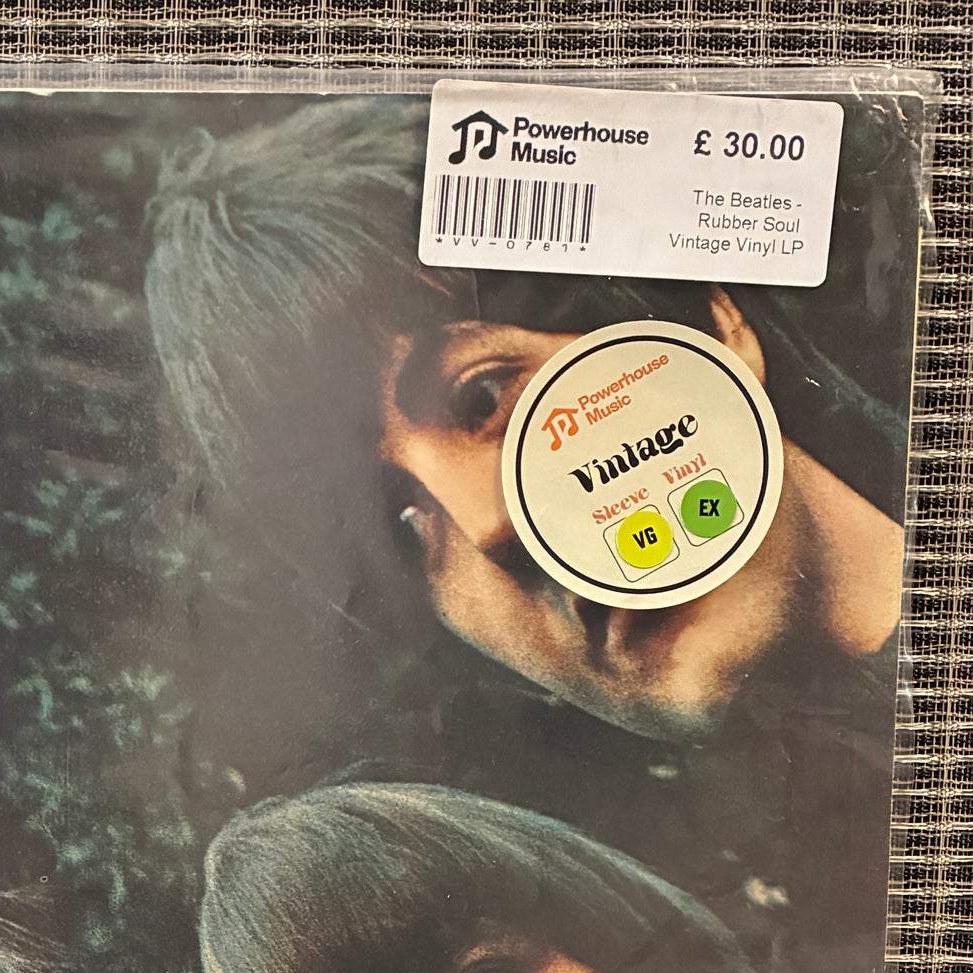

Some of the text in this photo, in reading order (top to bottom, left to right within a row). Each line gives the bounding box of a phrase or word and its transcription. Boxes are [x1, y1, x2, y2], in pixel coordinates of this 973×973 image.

[513, 116, 650, 146] Powerhouse
[693, 130, 805, 161] £ 30.00
[510, 142, 577, 166] Music
[692, 189, 725, 207] The
[730, 192, 792, 211] Beatles
[698, 213, 800, 234] Rubber Soul
[669, 233, 804, 257] Vintage Vinyl LP
[577, 353, 669, 411] Powerhouse
[585, 393, 632, 426] Music
[567, 414, 699, 493] Vintage
[661, 453, 707, 485] Vinyl
[591, 487, 650, 525] Sleeve
[698, 499, 720, 517] EX
[632, 526, 658, 549] VG
